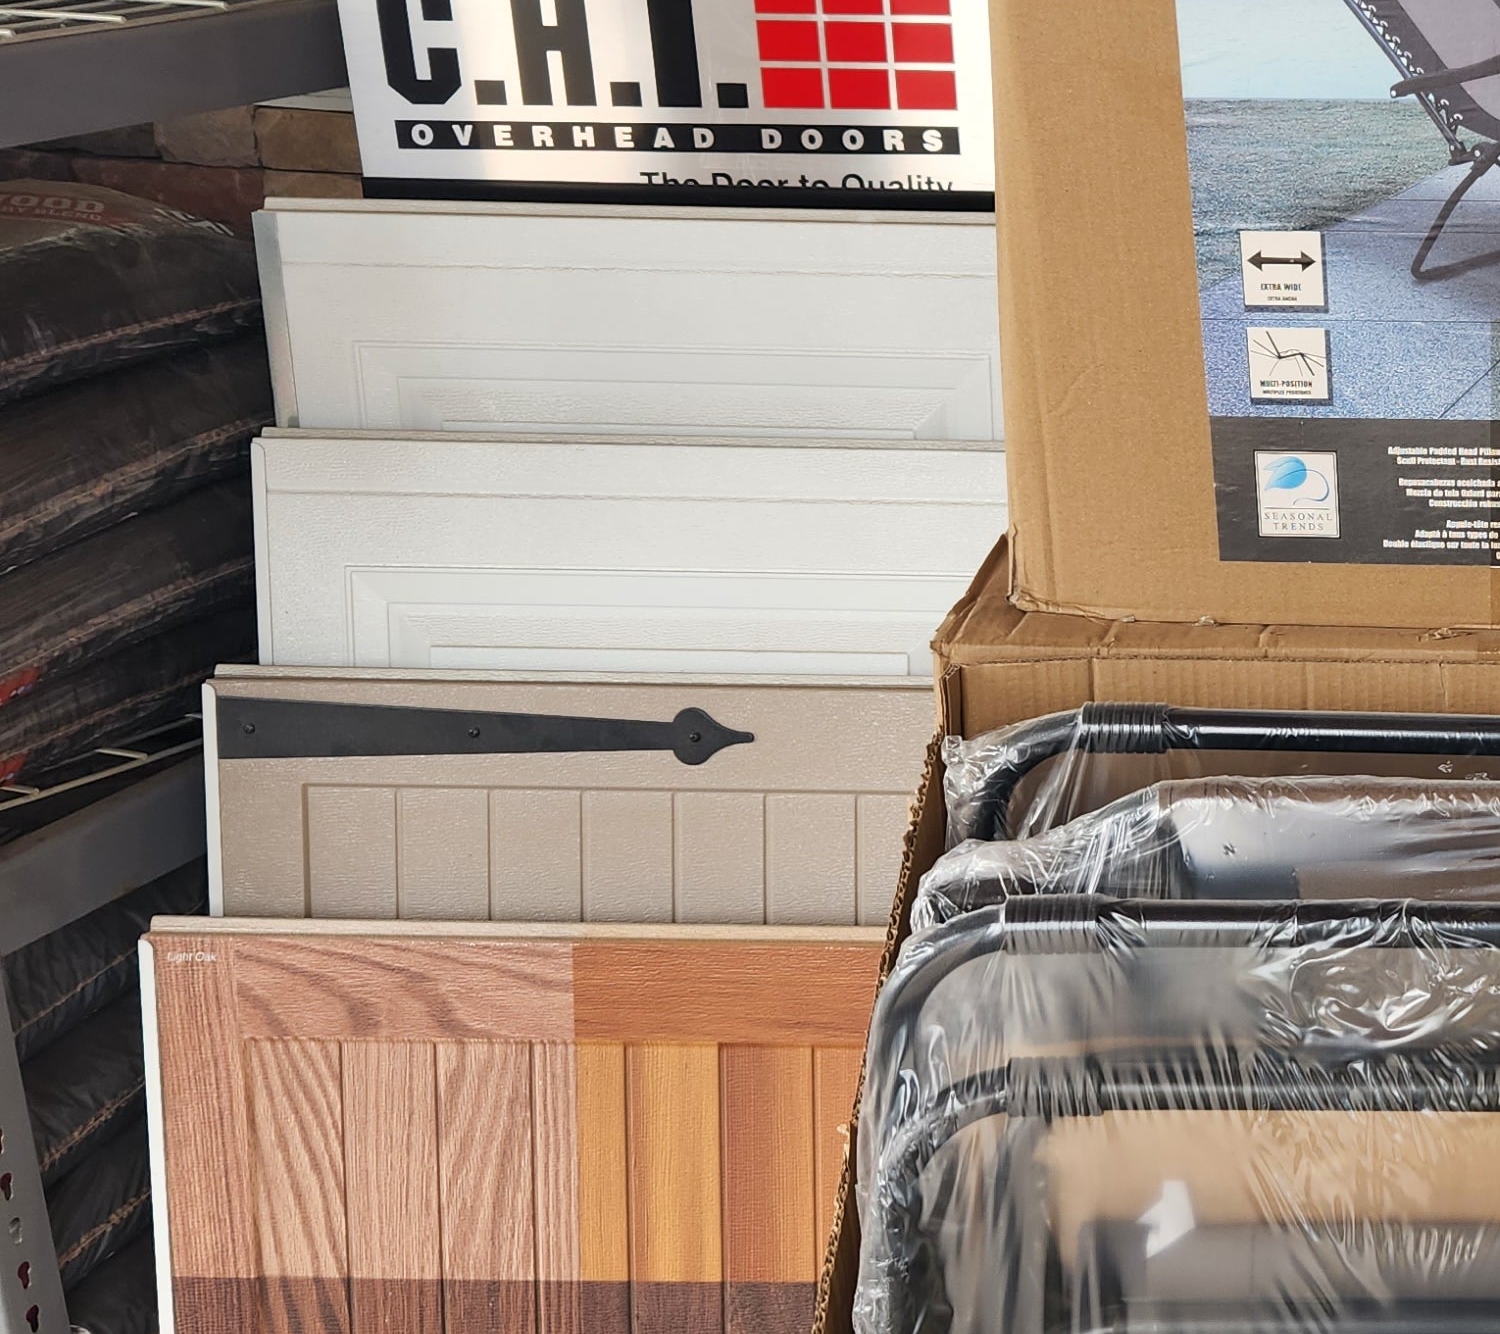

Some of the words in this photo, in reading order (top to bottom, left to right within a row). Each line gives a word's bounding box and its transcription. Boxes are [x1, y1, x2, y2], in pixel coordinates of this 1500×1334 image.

[411, 124, 716, 149] OVERHEAD
[761, 127, 943, 152] DOORS
[1264, 512, 1333, 521] SEASONAL
[1273, 523, 1324, 531] TRENDS
[195, 951, 217, 962] Oak
